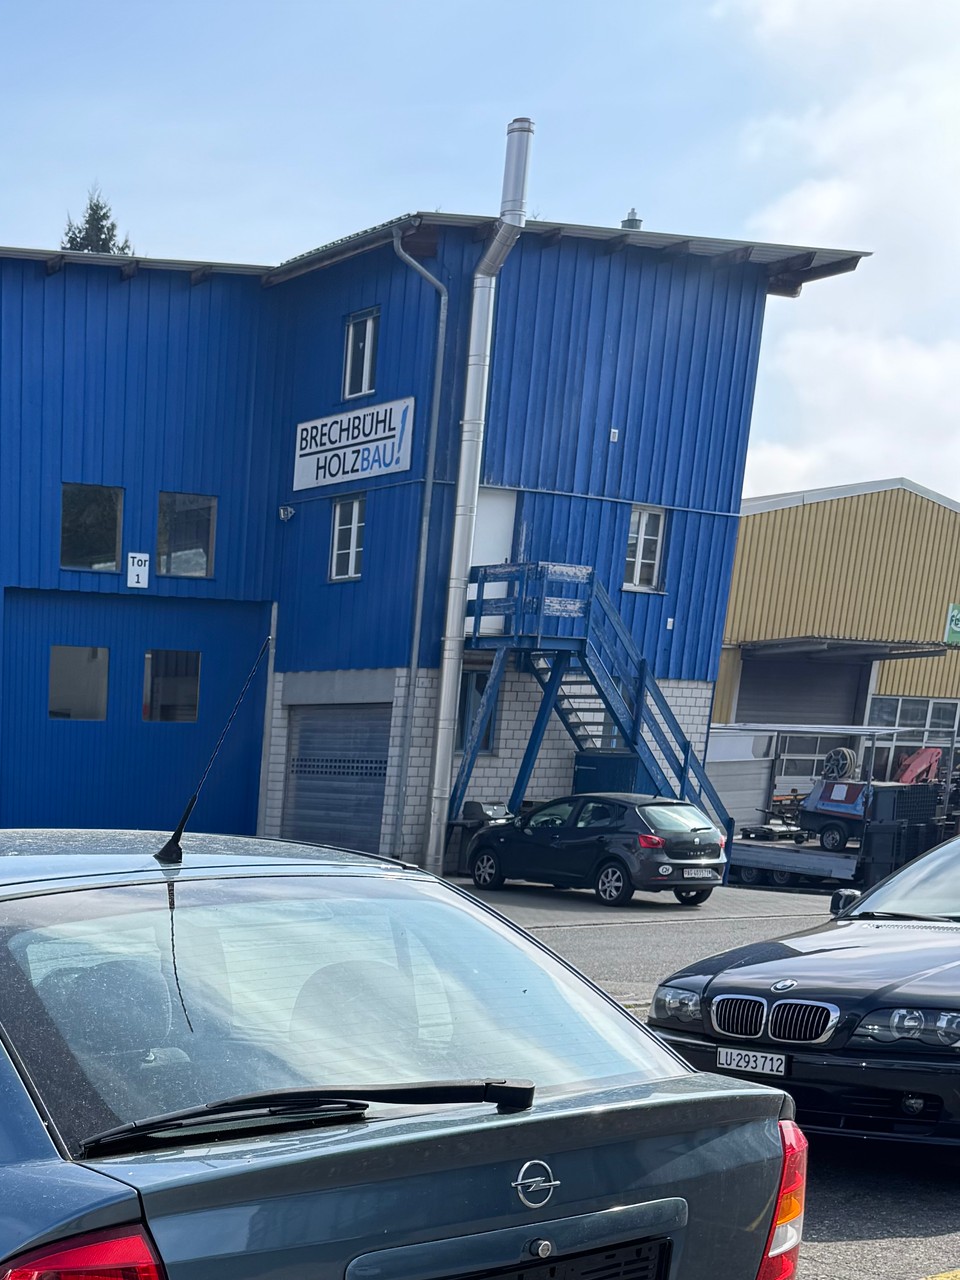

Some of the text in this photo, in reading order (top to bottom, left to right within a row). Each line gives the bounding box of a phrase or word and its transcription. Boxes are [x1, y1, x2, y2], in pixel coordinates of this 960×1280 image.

[300, 407, 396, 451] BRECHBÜHL
[130, 556, 148, 567] Tor
[135, 574, 141, 584] 1
